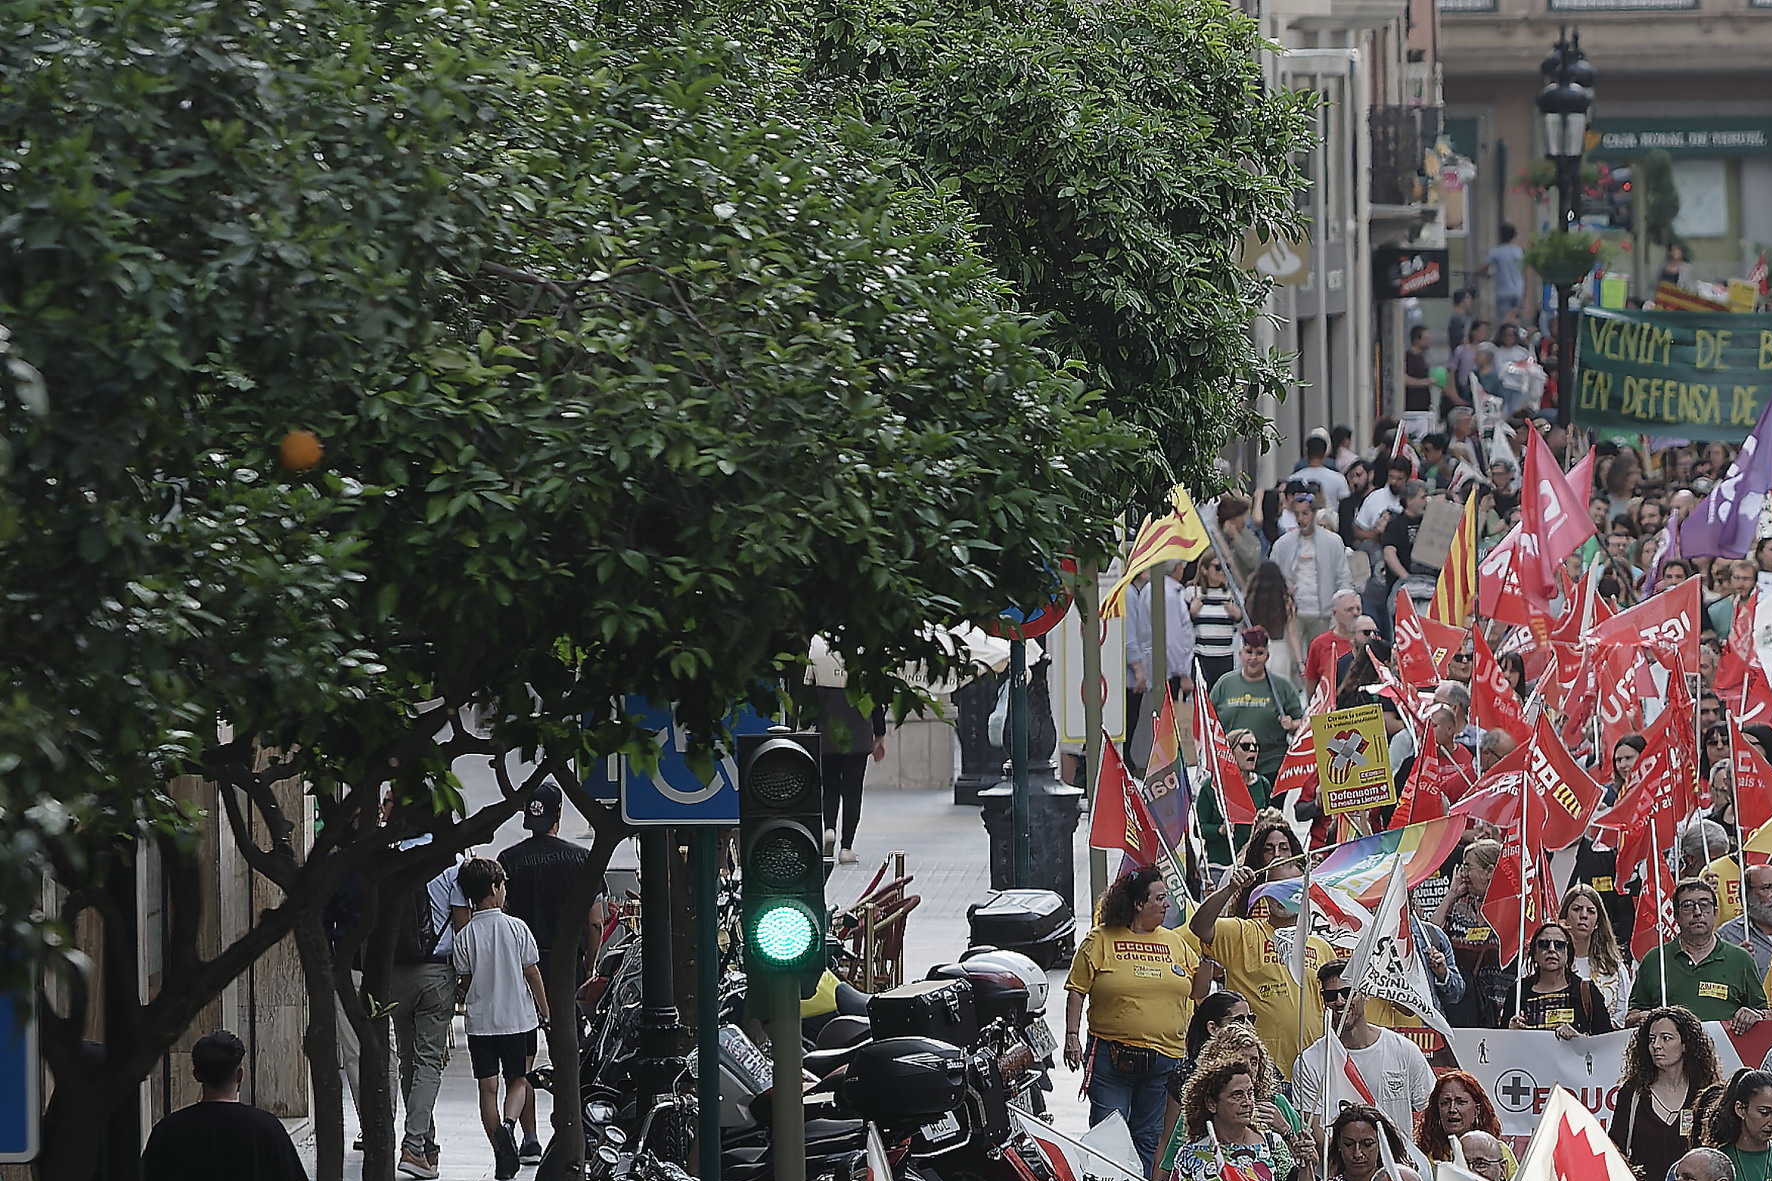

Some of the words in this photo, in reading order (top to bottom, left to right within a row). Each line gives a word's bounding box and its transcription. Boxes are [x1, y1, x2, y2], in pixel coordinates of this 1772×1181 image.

[1590, 316, 1671, 366] VENIM
[1696, 330, 1732, 369] DE
[1580, 369, 1614, 410] EN
[1731, 384, 1757, 426] DE
[1115, 941, 1154, 952] CCOO
[1116, 953, 1173, 963] educació
[1532, 1085, 1620, 1115] EDUC
